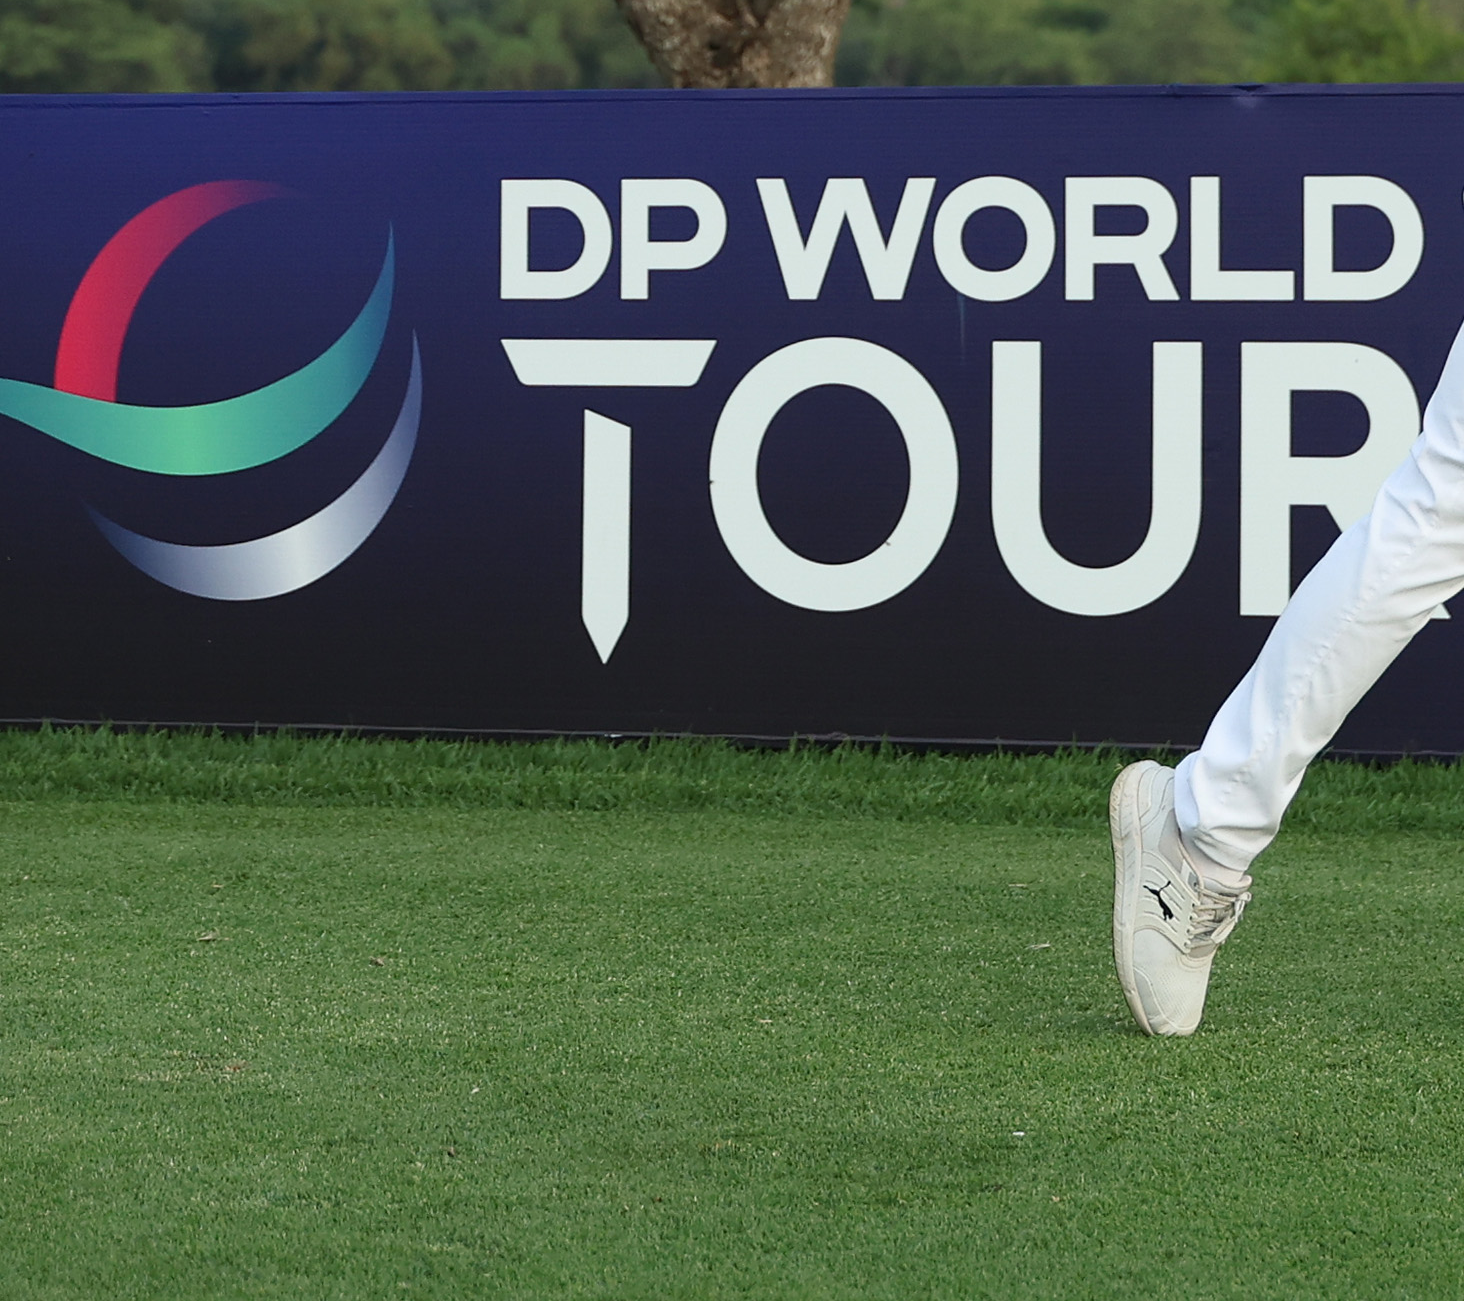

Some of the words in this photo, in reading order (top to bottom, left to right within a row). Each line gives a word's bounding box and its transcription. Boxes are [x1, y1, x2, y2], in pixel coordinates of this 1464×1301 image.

[501, 179, 726, 300] DP
[756, 176, 1423, 301] WORLD
[501, 337, 1451, 663] TOUR
